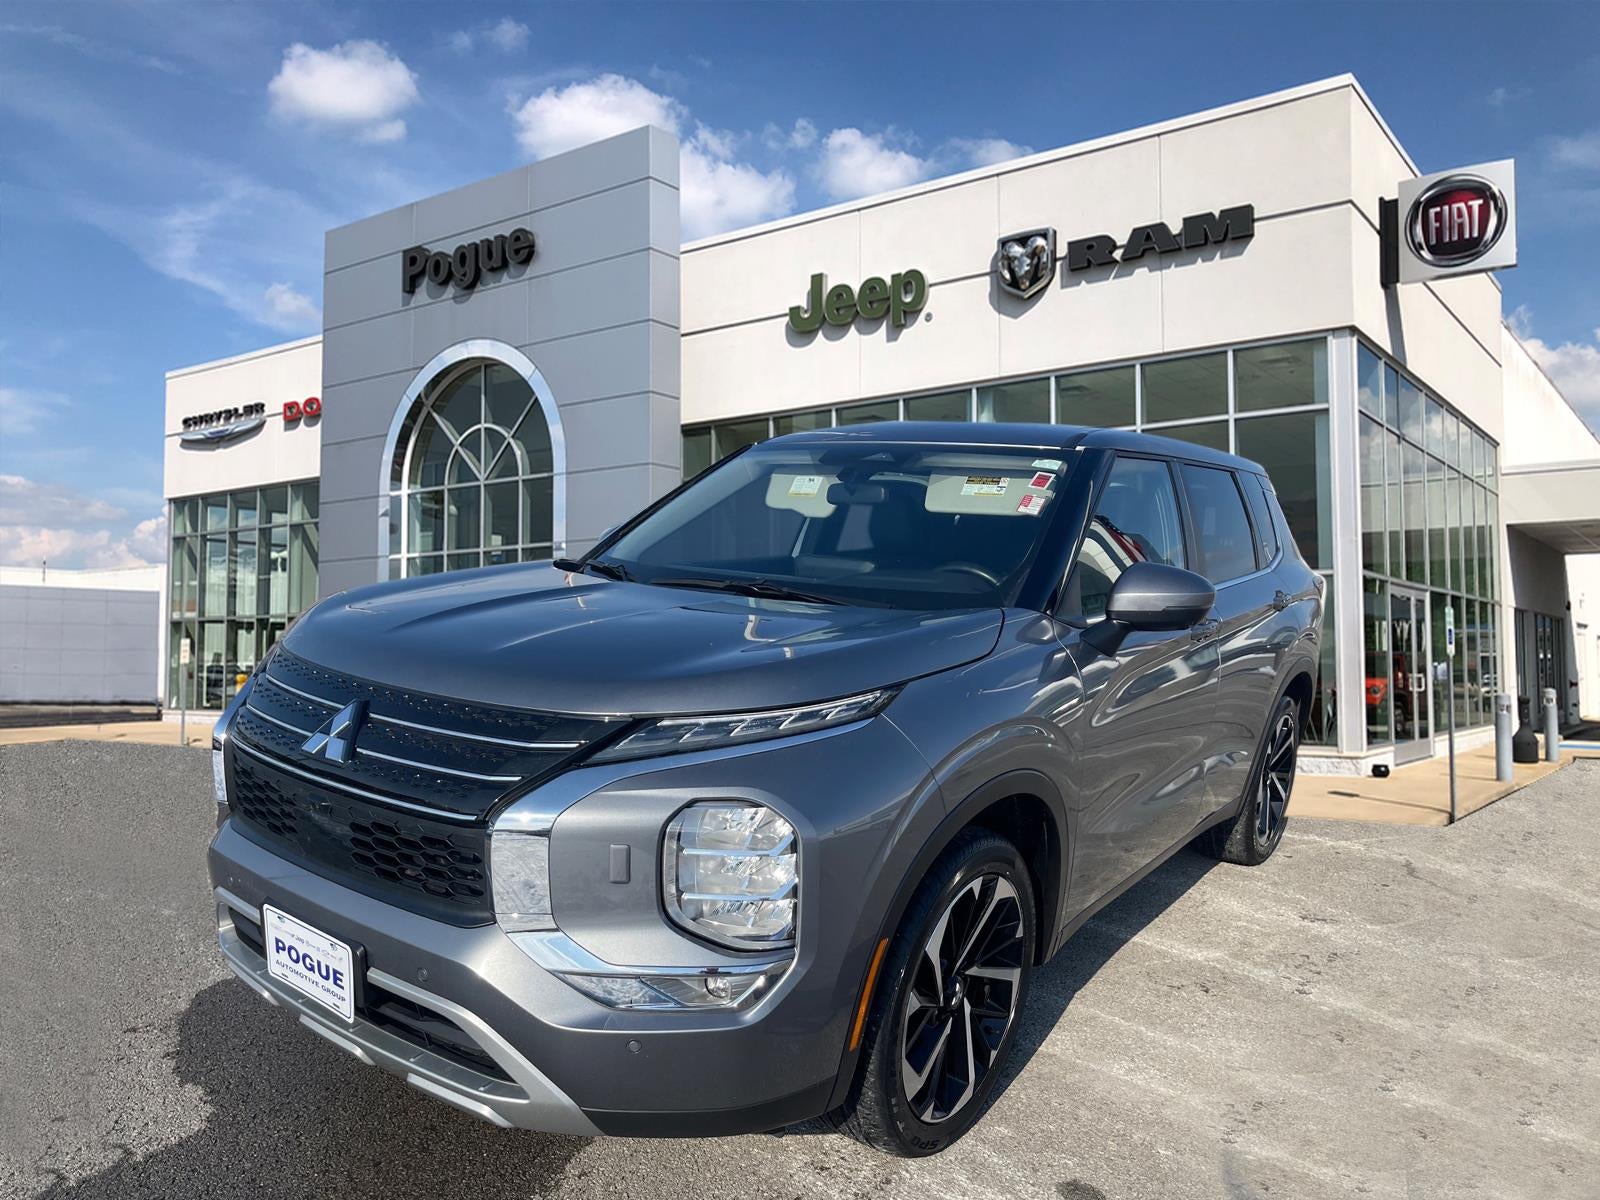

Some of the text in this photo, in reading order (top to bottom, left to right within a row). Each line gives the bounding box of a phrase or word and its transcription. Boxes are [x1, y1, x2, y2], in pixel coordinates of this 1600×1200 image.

[1067, 203, 1255, 272] RAM
[1428, 199, 1484, 246] FIAT
[402, 227, 536, 294] Pogue
[788, 268, 928, 333] Jeep
[274, 936, 345, 991] POGUE
[275, 959, 346, 1003] AUTOMOTIVE GROUP
